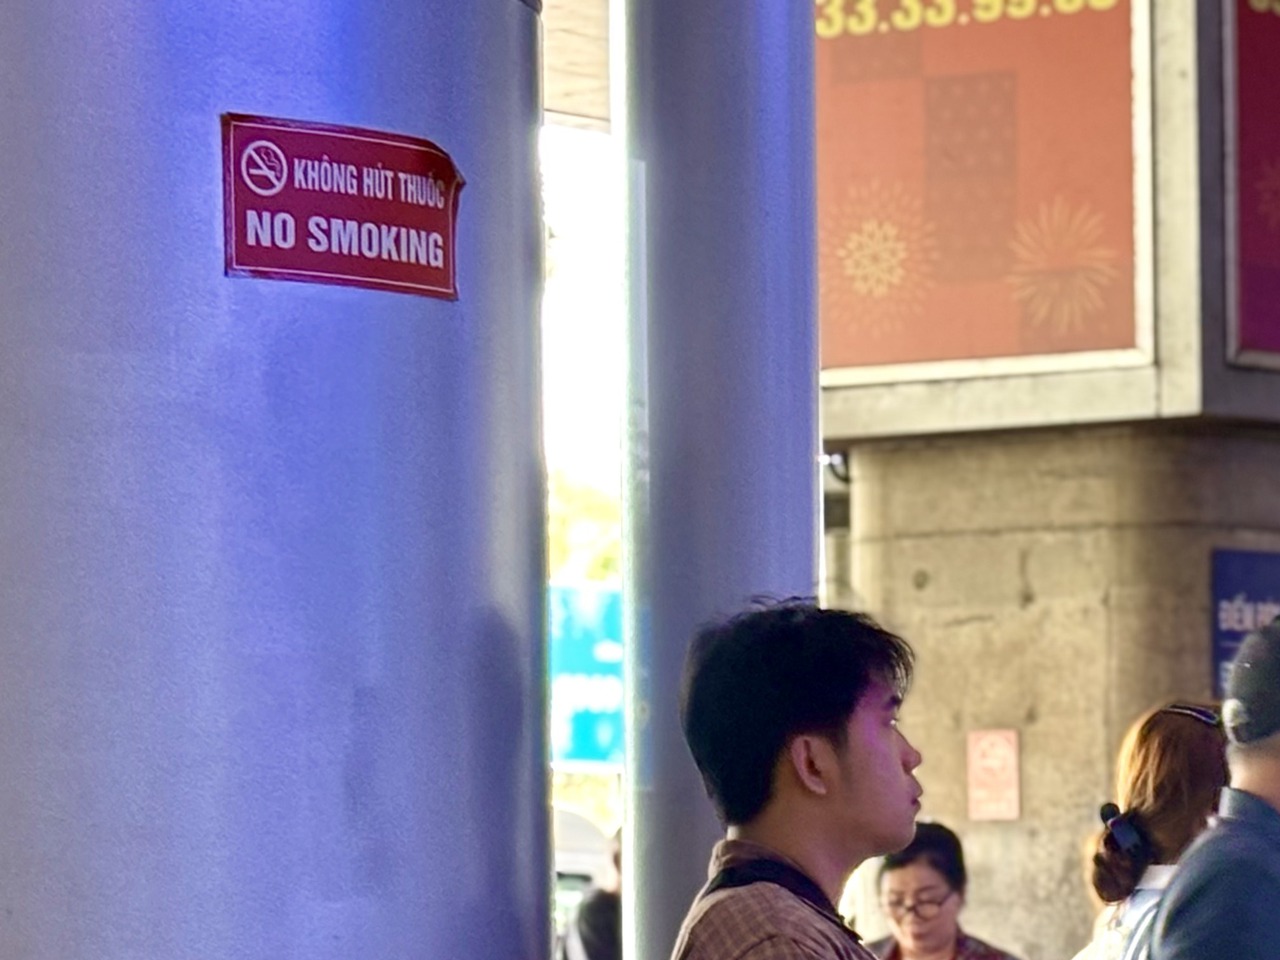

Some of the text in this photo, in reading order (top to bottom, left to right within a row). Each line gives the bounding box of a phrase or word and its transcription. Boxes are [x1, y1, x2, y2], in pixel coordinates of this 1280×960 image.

[293, 154, 358, 197] KHÔNG
[363, 161, 395, 201] HÚT
[245, 209, 445, 270] NO SMOKING
